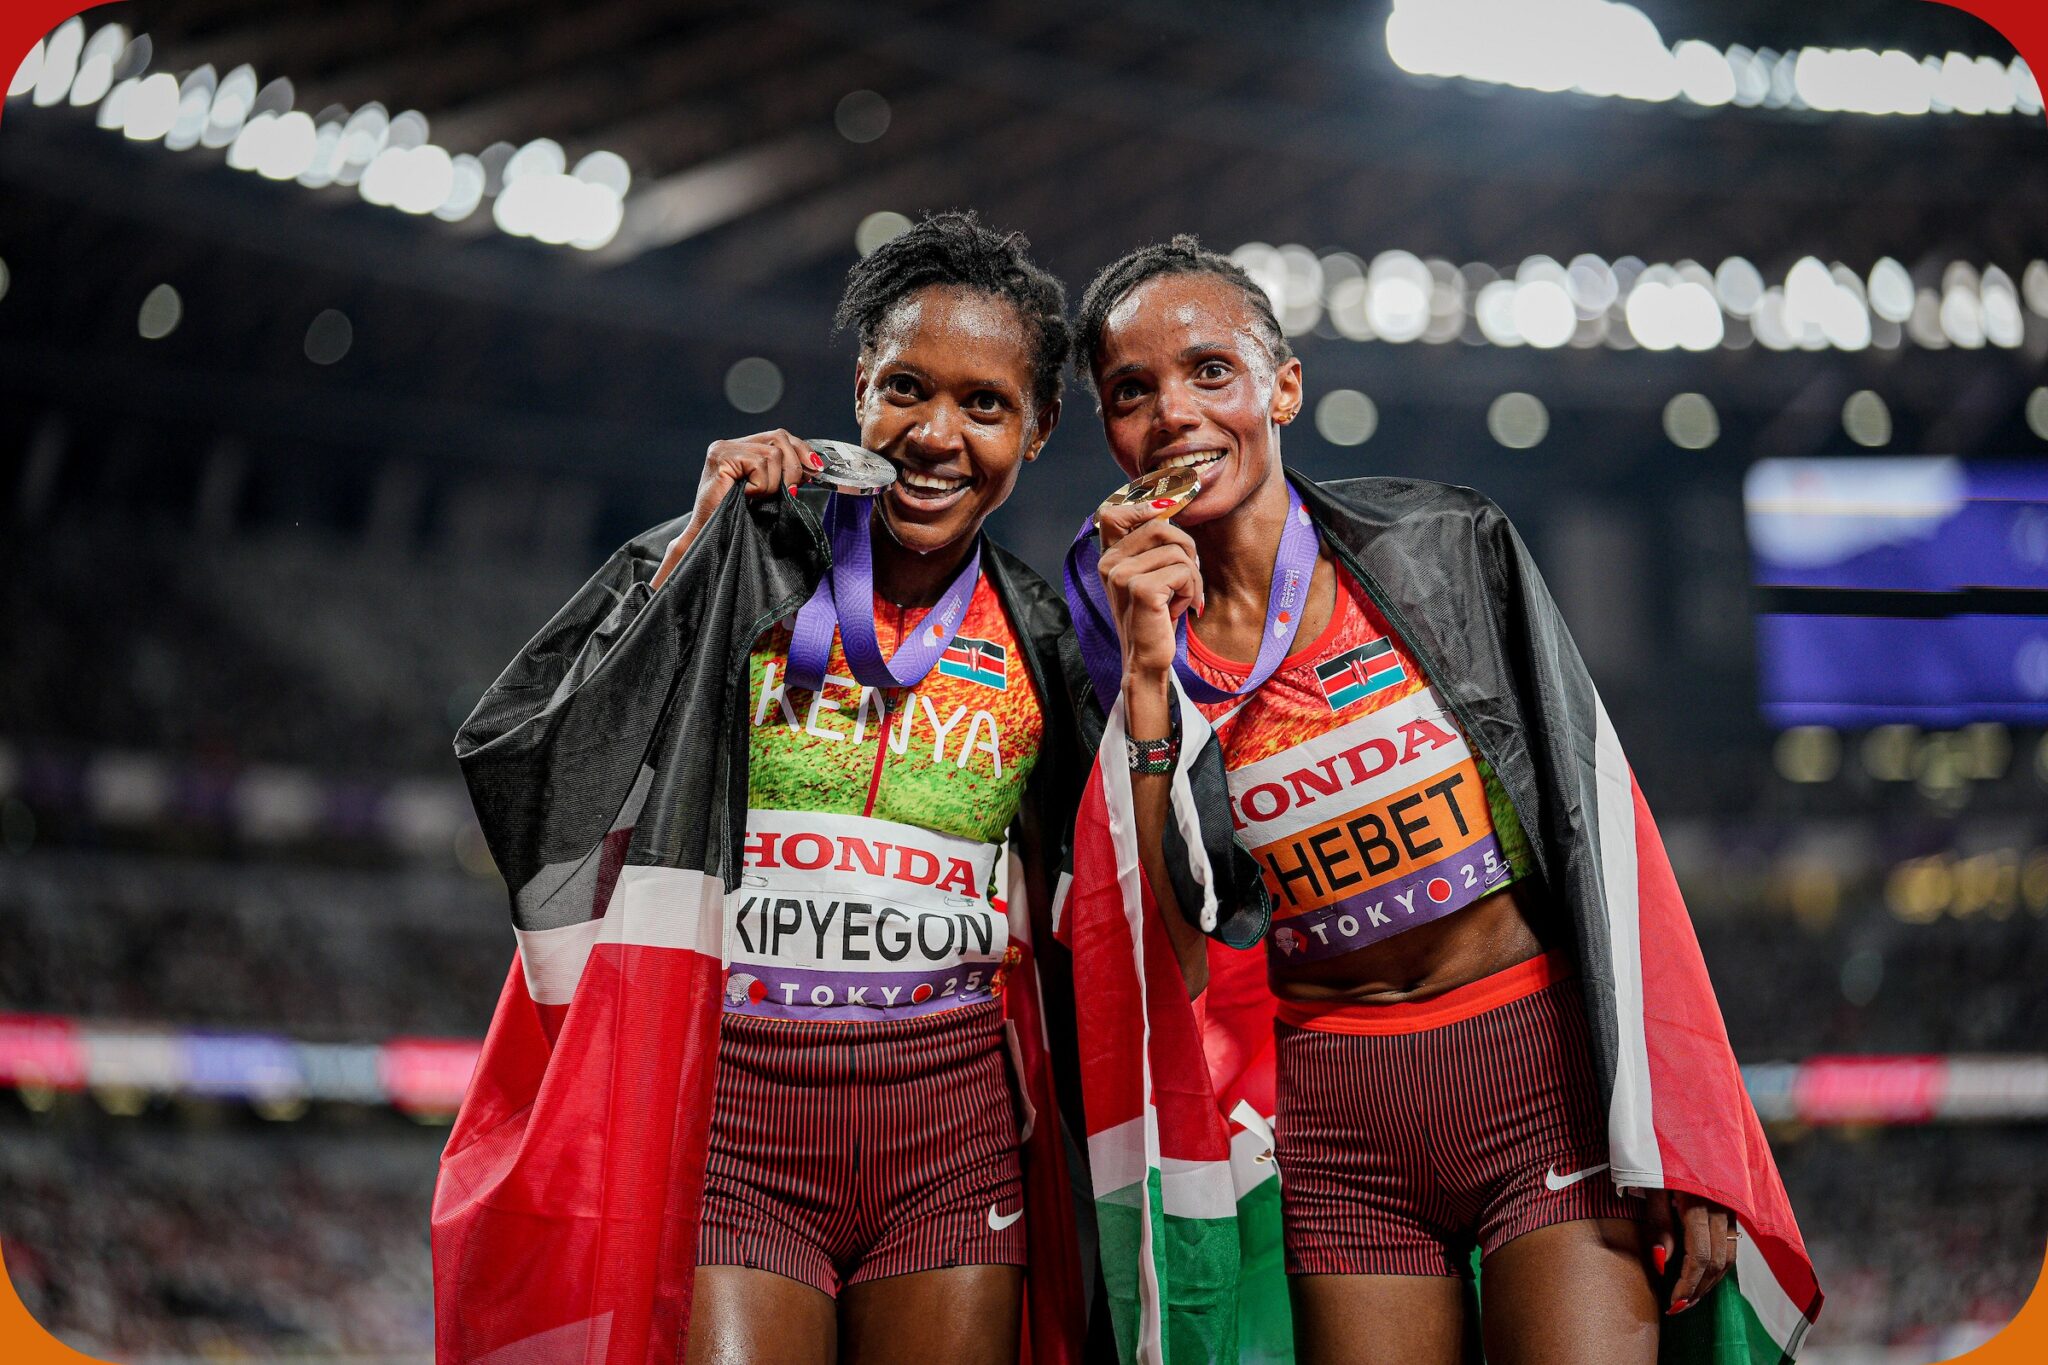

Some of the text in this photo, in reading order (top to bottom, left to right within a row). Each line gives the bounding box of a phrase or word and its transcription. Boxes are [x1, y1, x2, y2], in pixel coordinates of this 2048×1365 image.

[754, 662, 1002, 779] KENYA
[743, 832, 981, 899] HONDA
[1262, 772, 1469, 912] HEBET
[1460, 849, 1498, 889] 25
[940, 971, 983, 997] 25
